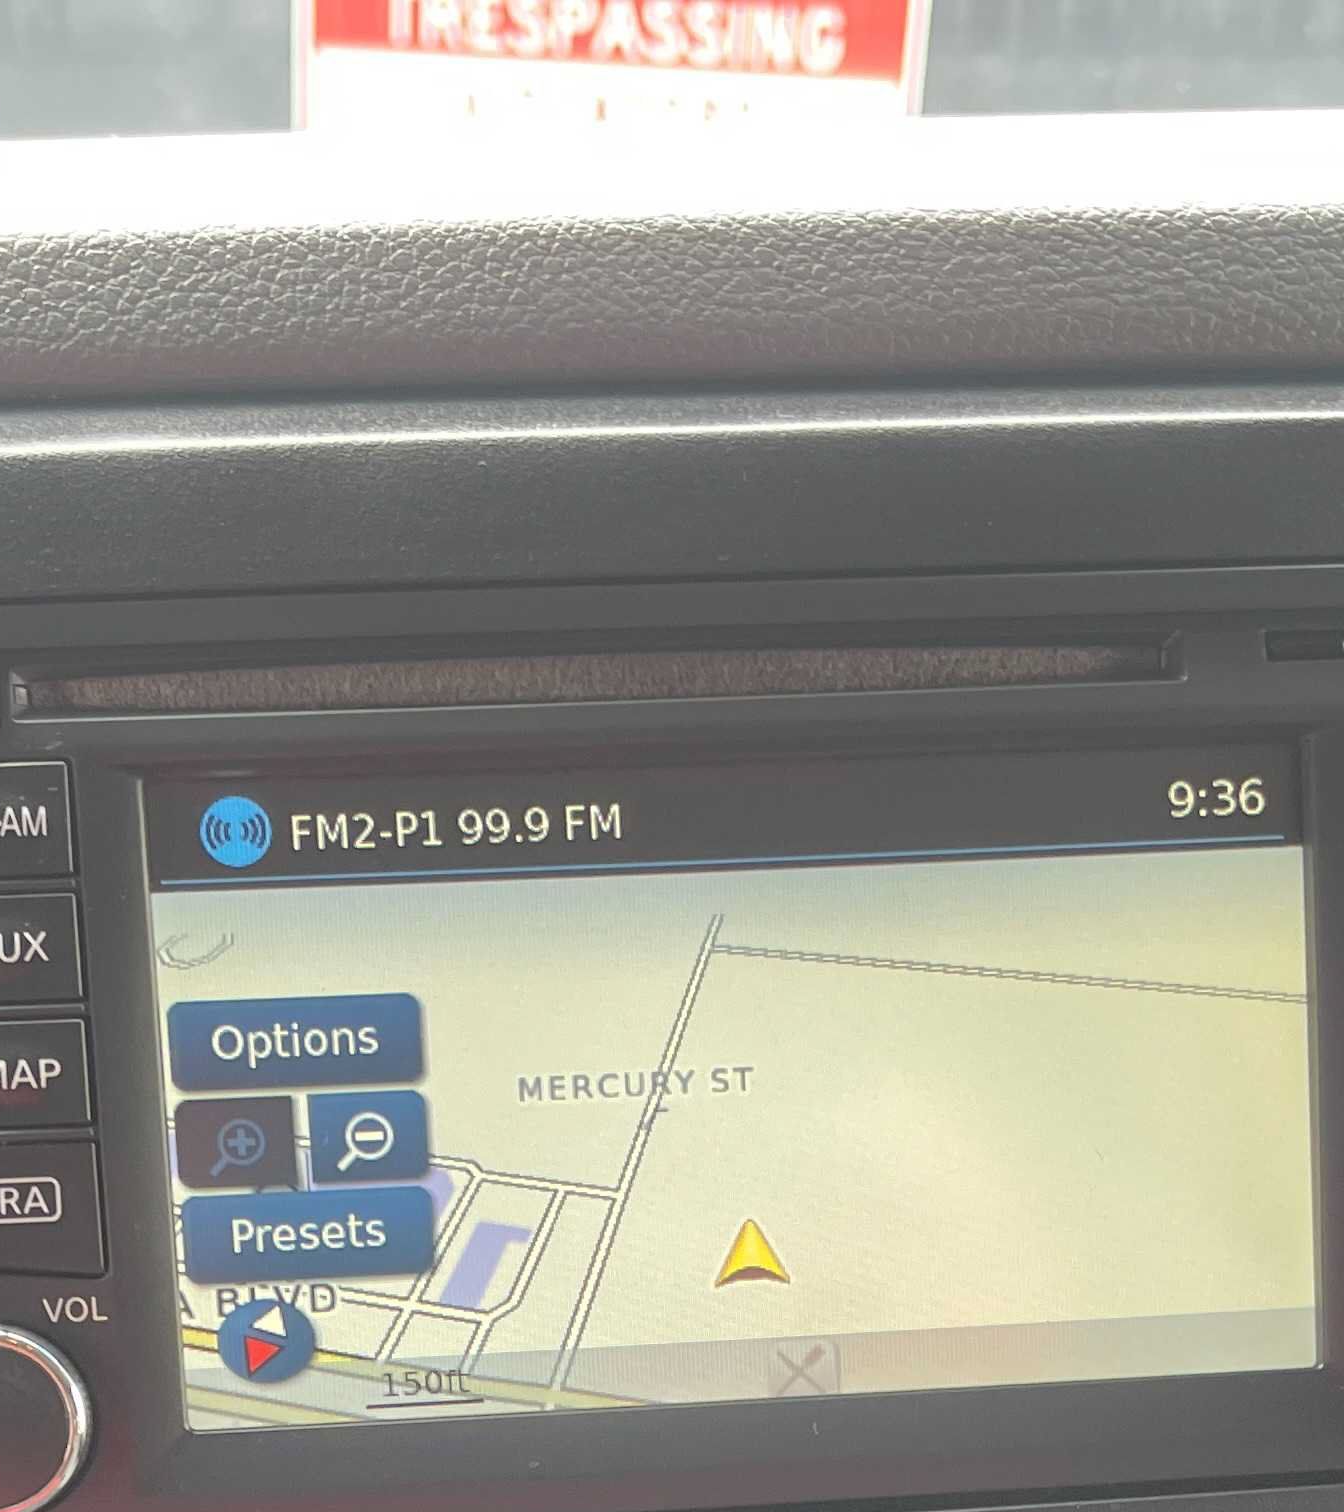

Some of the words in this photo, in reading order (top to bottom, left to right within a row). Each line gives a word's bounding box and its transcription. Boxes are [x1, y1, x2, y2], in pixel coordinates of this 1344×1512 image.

[1167, 777, 1266, 818] 9:36
[290, 809, 443, 851] FM2-P1
[457, 805, 550, 847] 99.9
[564, 803, 622, 842] FM
[211, 1022, 379, 1069] Options
[518, 1069, 695, 1102] MERCURY
[711, 1066, 754, 1093] ST
[231, 1213, 386, 1253] Presets
[42, 1296, 109, 1323] VOL
[382, 1369, 470, 1397] 150ft
